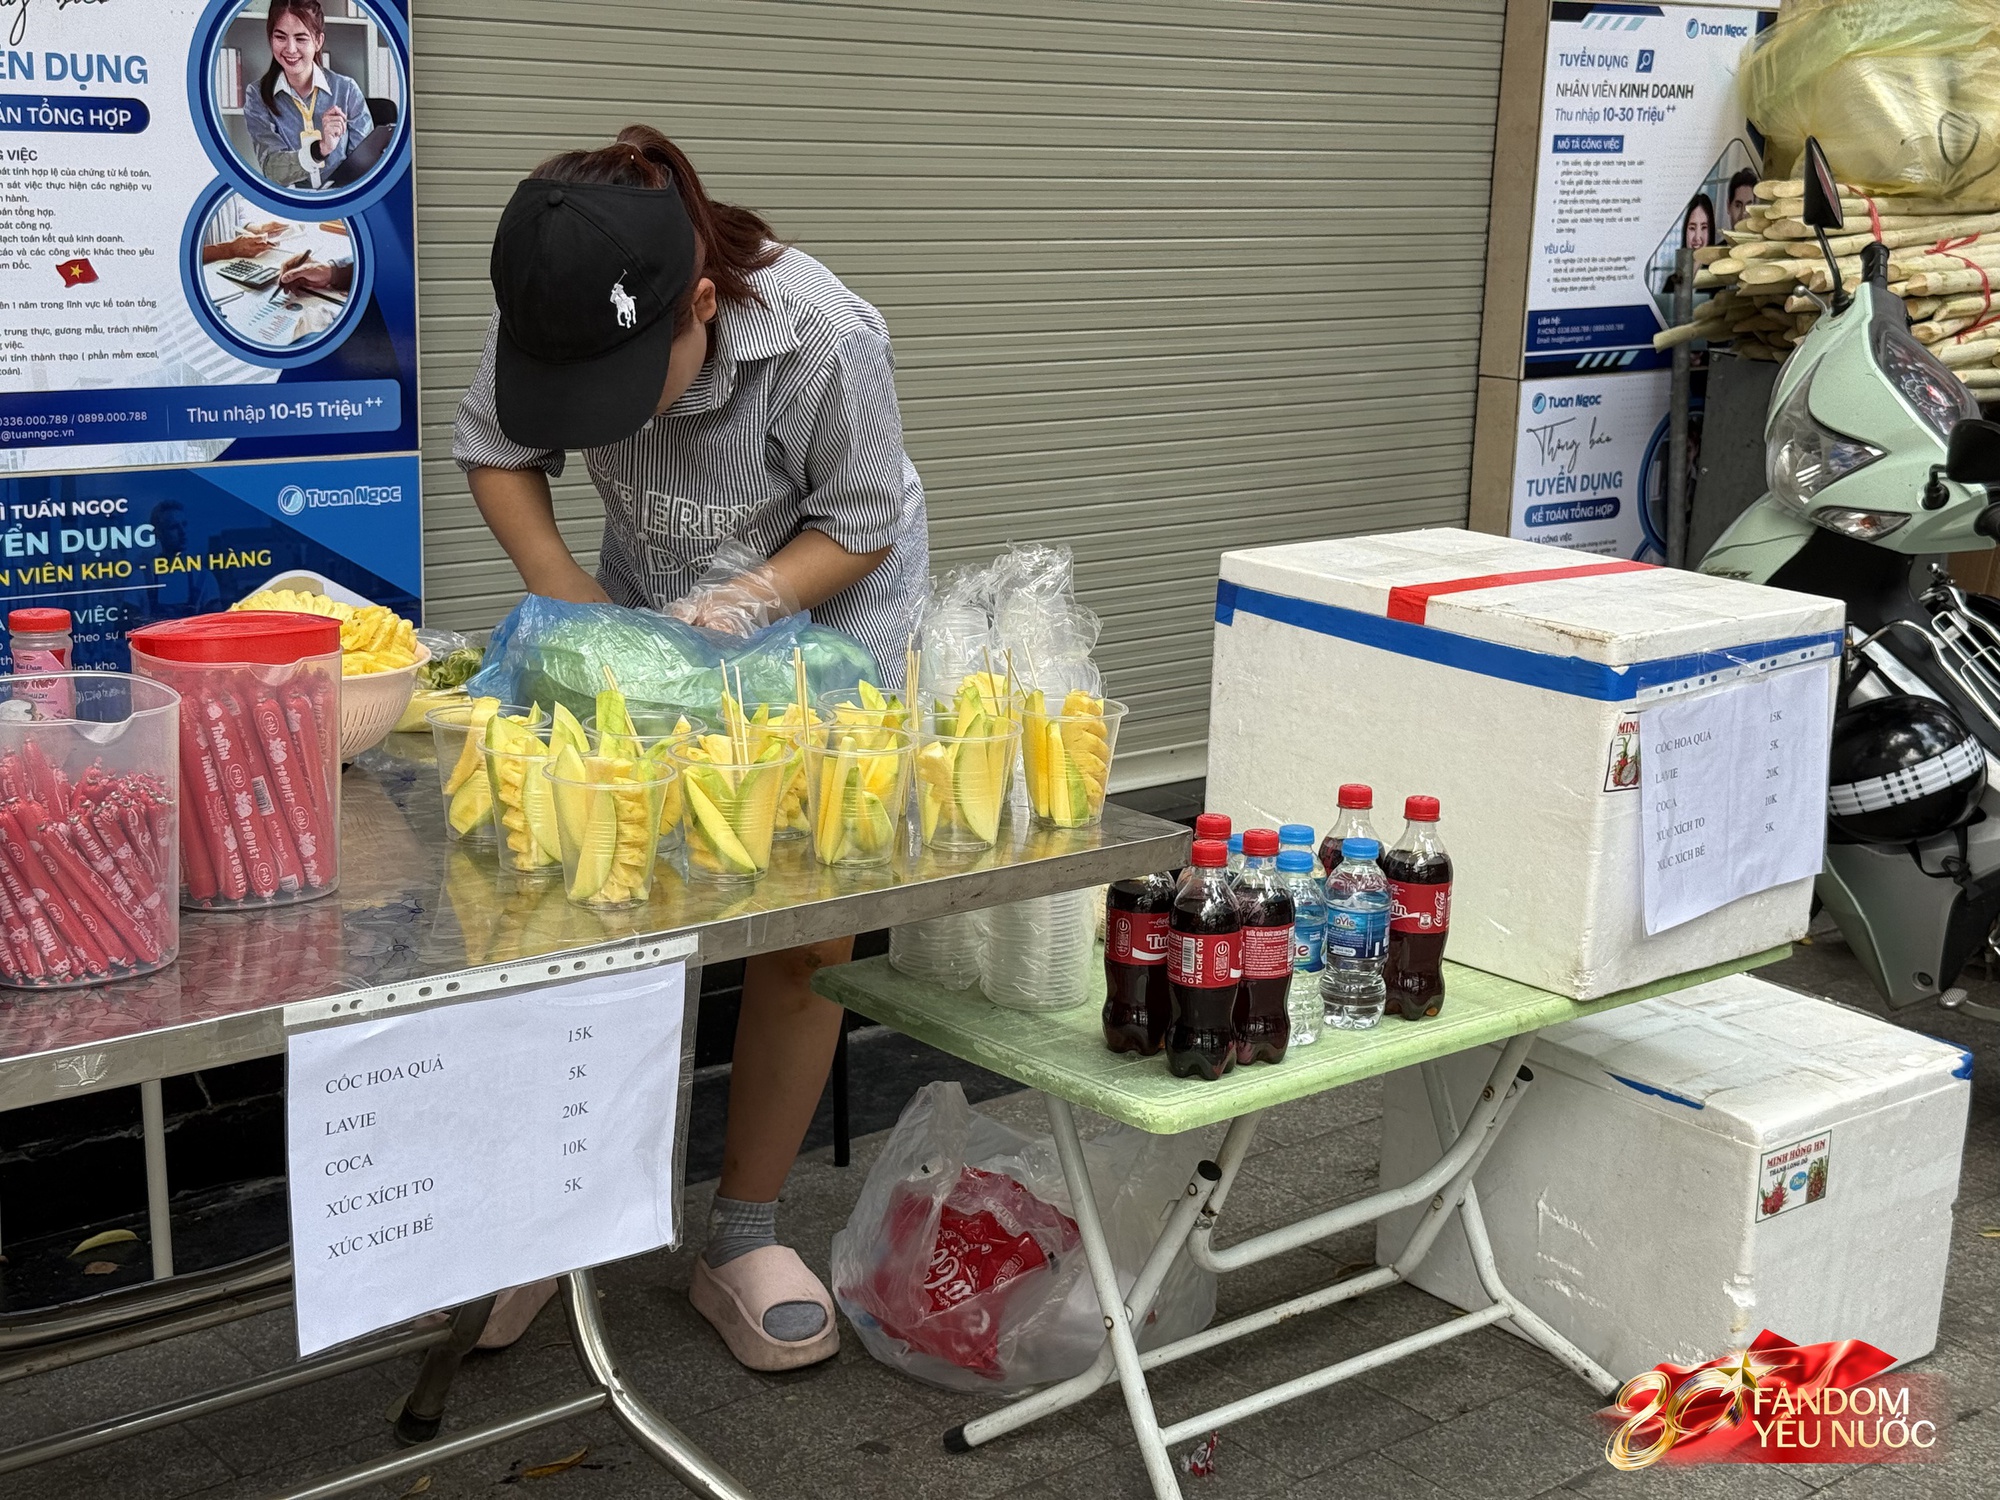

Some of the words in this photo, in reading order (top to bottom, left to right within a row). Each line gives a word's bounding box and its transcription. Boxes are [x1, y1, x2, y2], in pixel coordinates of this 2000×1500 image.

[1559, 46, 1595, 67] TUYỂN
[1597, 54, 1629, 71] DỤNG
[45, 52, 148, 91] DỤNG
[1556, 79, 1589, 98] NHÂN
[1592, 79, 1617, 98] VIÊN
[1619, 83, 1649, 98] KINH
[1652, 84, 1694, 99] DOANH
[27, 97, 84, 126] TỔNG
[90, 108, 132, 131] HỢP
[1555, 108, 1573, 121] Thu
[1575, 108, 1600, 123] nhập
[1602, 107, 1634, 121] 10-30
[1581, 138, 1602, 149] CÔNG
[1603, 138, 1620, 151] VIỆC
[7, 147, 38, 163] VIỆC
[32, 168, 49, 178] hợp
[61, 168, 76, 176] của
[78, 168, 105, 178] chứng
[25, 182, 42, 191] việc
[46, 182, 66, 190] thực
[69, 182, 88, 191] hiện
[110, 182, 139, 192] nghiệp
[142, 184, 152, 192] vụ
[15, 206, 35, 217] tổng
[15, 221, 37, 231] công
[20, 235, 40, 243] toán
[42, 233, 56, 242] kết
[58, 233, 74, 244] quả
[77, 235, 94, 243] kinh
[49, 249, 70, 257] công
[74, 248, 91, 257] việc
[94, 248, 114, 256] khác
[19, 301, 38, 309] năm
[41, 301, 64, 310] trong
[85, 300, 100, 309] vực
[116, 300, 135, 308] toán
[138, 297, 157, 308] tổng
[4, 328, 28, 337] trung
[108, 326, 129, 334] trách
[133, 325, 158, 335] nhiệm
[11, 353, 27, 361] tính
[31, 353, 56, 361] thành
[59, 352, 78, 362] thạo
[88, 350, 109, 361] phần
[112, 349, 133, 359] mềm
[77, 412, 148, 424] 0899.000.788
[187, 407, 219, 423] Thu
[224, 406, 266, 426] nhập
[270, 402, 313, 420] 10-15
[0, 428, 75, 442] @tuanngoc.vn
[1526, 465, 1577, 497] TUYỂN
[1580, 471, 1623, 496] DỤNG
[11, 498, 66, 520] TUẤN
[72, 498, 129, 518] NGỌC
[1545, 507, 1569, 522] TOÁN
[1594, 503, 1614, 518] HỢP
[61, 524, 156, 557] DỤNG
[18, 562, 74, 585] VIÊN
[81, 560, 133, 581] KHO
[154, 552, 201, 575] BÁN
[208, 547, 273, 570] HÀNG
[74, 604, 119, 627] VIỆC
[73, 633, 100, 643] theo
[105, 630, 119, 642] sự
[1770, 710, 1782, 722] 15K
[1674, 736, 1693, 750] HOA
[1769, 739, 1779, 750] 5K
[1655, 767, 1678, 784] LAVIE
[1765, 766, 1779, 779] 20K
[1764, 793, 1778, 806] 10K
[1694, 816, 1705, 829] TO
[1764, 822, 1775, 833] 5K
[567, 1025, 594, 1043] 15K
[366, 1066, 405, 1087] HOA
[407, 1053, 445, 1080] QUẢ
[568, 1065, 588, 1081] 5K
[561, 1101, 589, 1119] 20K
[324, 1111, 378, 1137] LAVIE
[561, 1139, 588, 1156] 10K
[1766, 1153, 1789, 1168] MINH
[1813, 1139, 1826, 1151] HN
[324, 1153, 374, 1177] COCA
[563, 1176, 584, 1194] 5K
[325, 1195, 363, 1219] XÚC
[366, 1182, 409, 1208] XÍCH
[411, 1177, 435, 1196] TO
[327, 1236, 364, 1260] XÚC
[367, 1224, 409, 1249] XÍCH
[412, 1215, 435, 1236] BÉ
